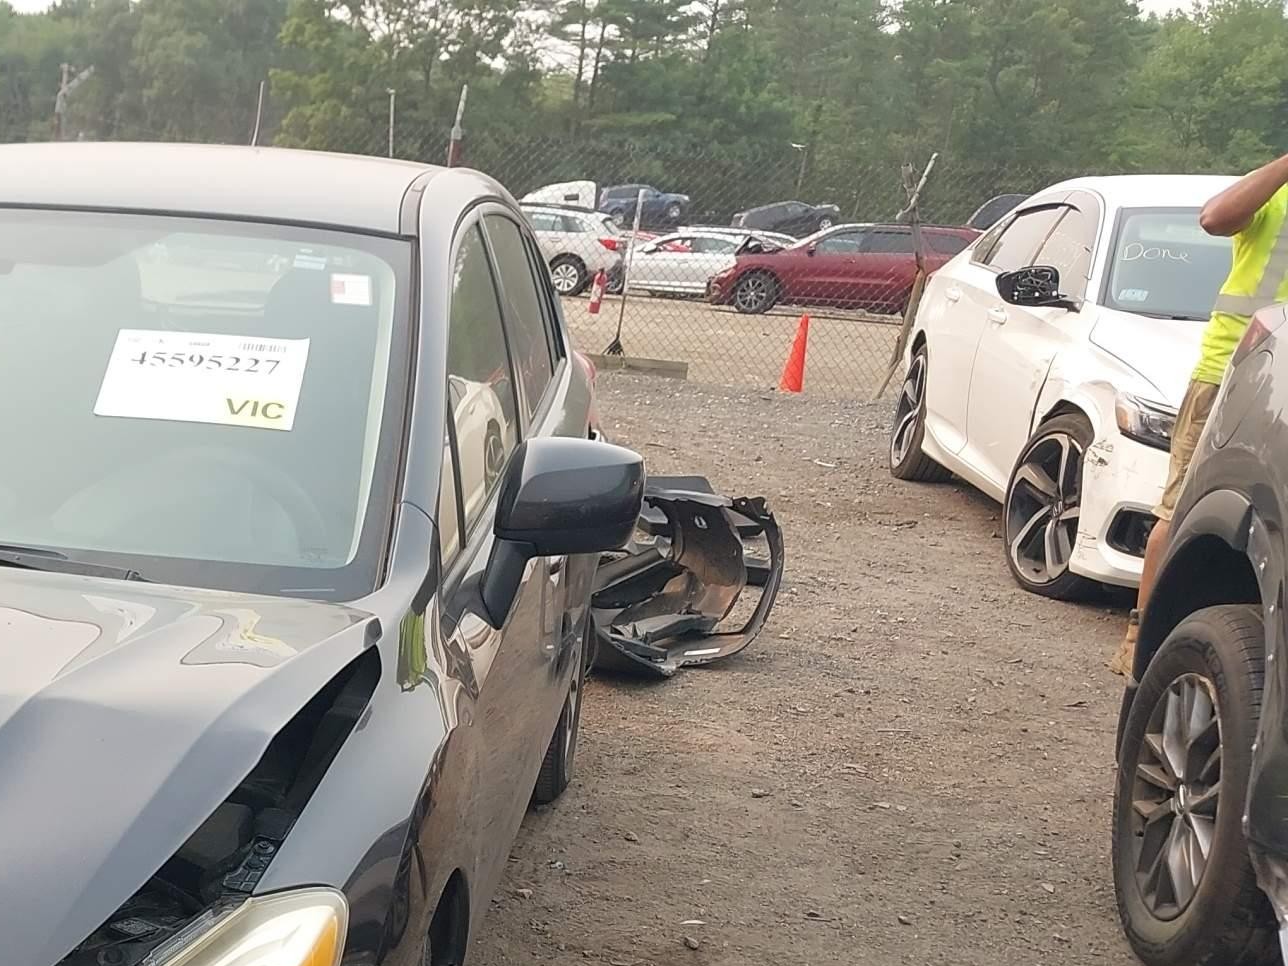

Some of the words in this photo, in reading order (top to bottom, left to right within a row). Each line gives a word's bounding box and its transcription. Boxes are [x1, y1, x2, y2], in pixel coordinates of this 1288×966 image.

[1120, 242, 1193, 263] Done
[130, 350, 281, 375] 45595227
[226, 398, 285, 420] VIC
